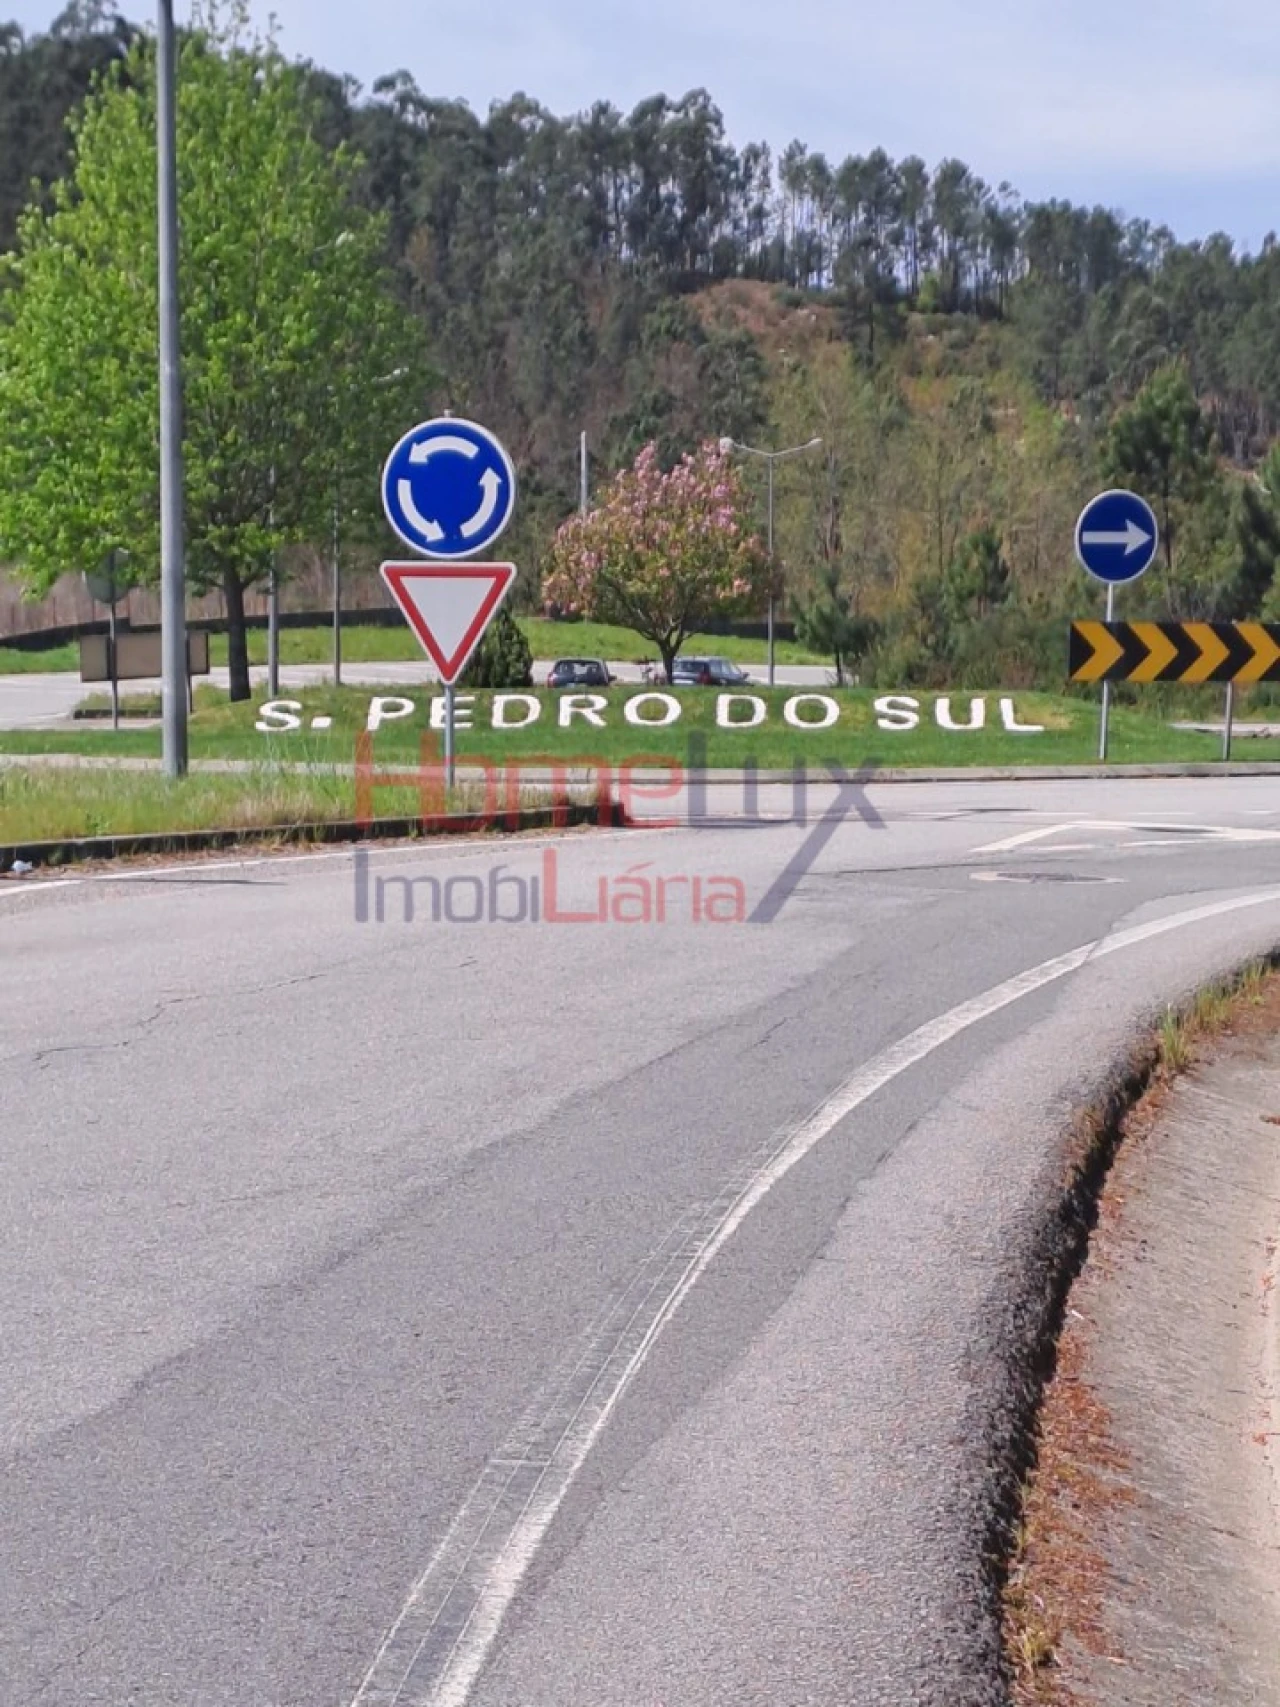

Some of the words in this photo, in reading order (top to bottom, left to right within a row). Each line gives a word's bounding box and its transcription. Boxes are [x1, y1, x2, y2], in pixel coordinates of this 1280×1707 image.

[255, 699, 332, 731] S.
[366, 692, 682, 731] PEDRO
[716, 693, 840, 728] DO
[874, 696, 1044, 731] SUL
